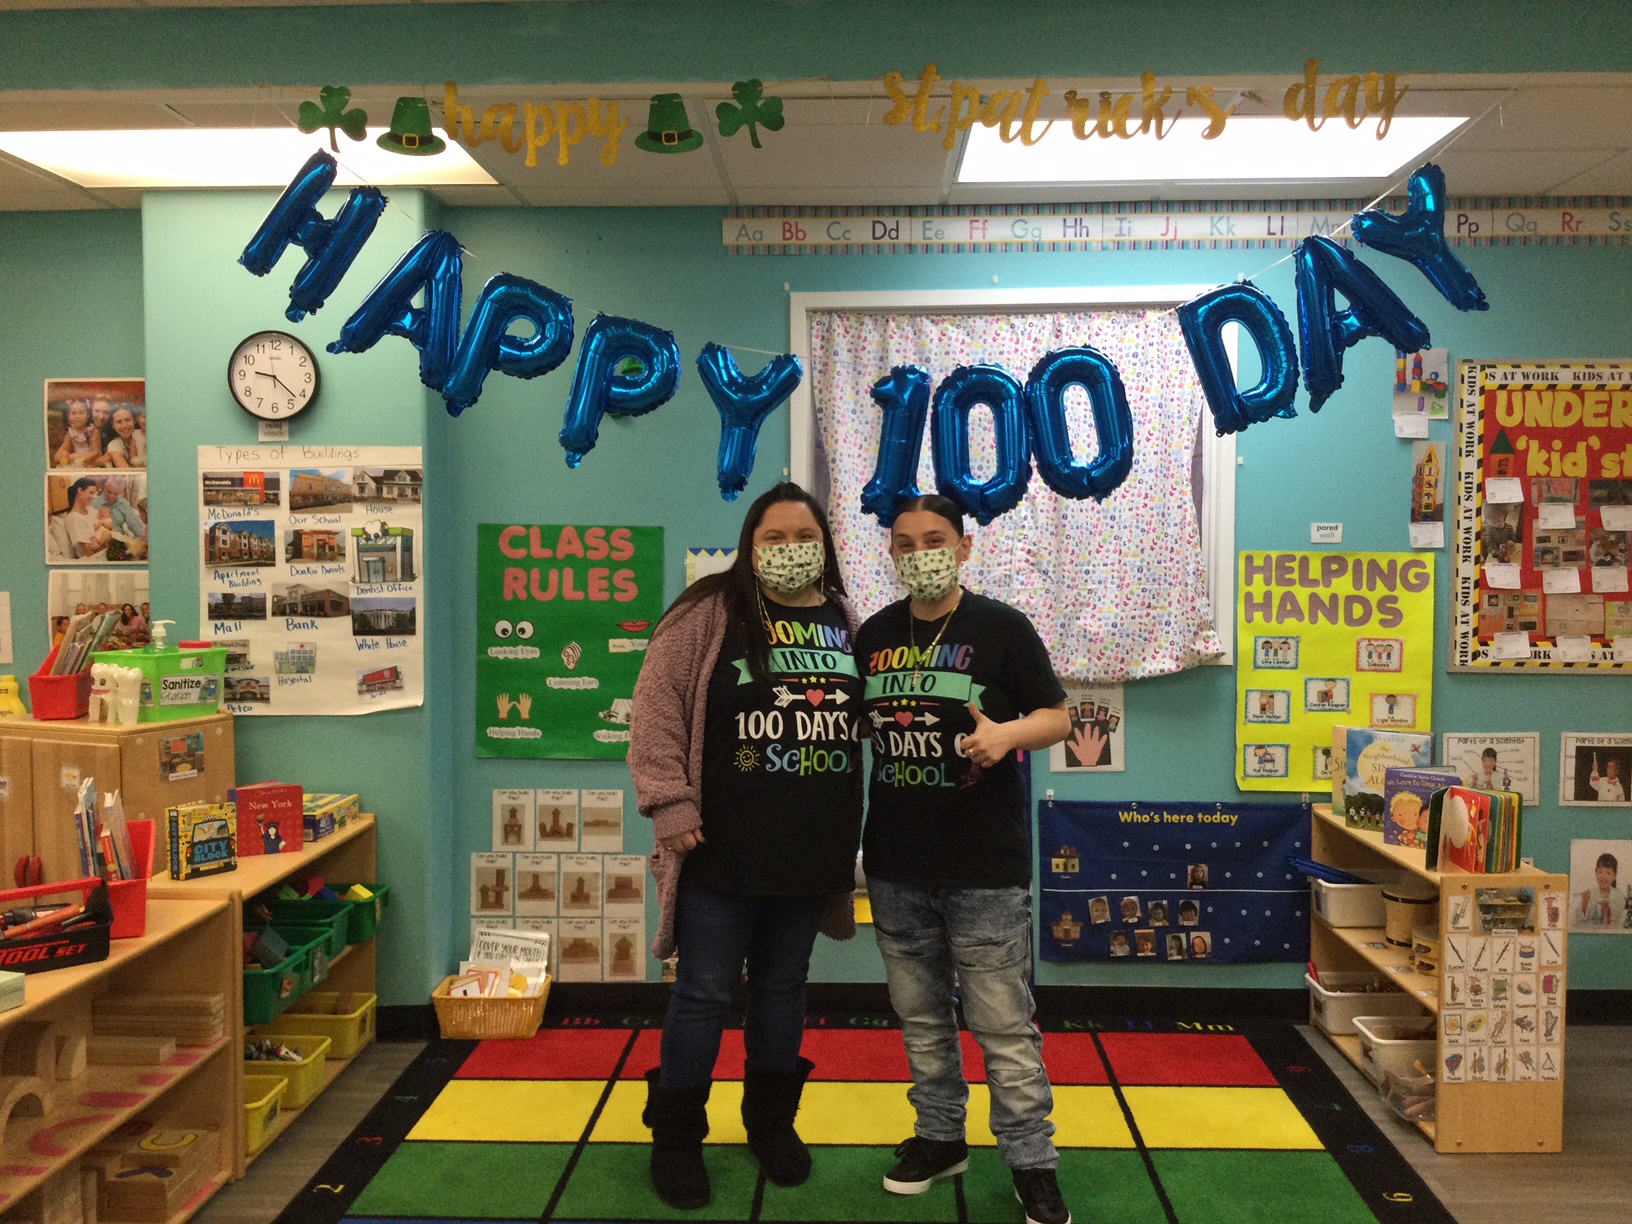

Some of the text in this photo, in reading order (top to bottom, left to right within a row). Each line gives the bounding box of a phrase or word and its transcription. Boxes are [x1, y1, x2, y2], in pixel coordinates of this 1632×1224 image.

[1283, 57, 1411, 141] day
[443, 81, 631, 167] happy
[734, 219, 764, 242] Aa
[781, 219, 807, 242] Bb
[826, 220, 852, 242] Cc
[871, 219, 900, 241] Dd
[921, 220, 945, 242] Ee
[968, 219, 989, 241] Ff
[1010, 218, 1041, 245] Gg
[1062, 216, 1090, 239] Hh
[1114, 216, 1131, 238] Ii
[1160, 215, 1178, 242] Jj
[1209, 216, 1236, 237] Kk
[1267, 215, 1284, 236] Ll
[1456, 213, 1480, 239] Pp
[1505, 212, 1538, 236] Qq
[1561, 211, 1584, 232] Rr
[238, 149, 1489, 524] HAPPY 100 DAY
[255, 343, 265, 354] 11
[269, 339, 281, 351] 12
[289, 345, 295, 355] 1
[243, 355, 255, 366] 10
[299, 356, 307, 367] 2
[239, 369, 246, 381] 9
[304, 372, 312, 384] 3
[1501, 371, 1517, 382] AT
[1521, 371, 1560, 381] WORK
[1572, 371, 1603, 381] KIDS
[1608, 371, 1623, 381] AT
[244, 386, 251, 397] 8
[299, 389, 306, 400] 4
[256, 397, 264, 408] 7
[271, 402, 278, 414] 6
[287, 398, 295, 410] 5
[1465, 365, 1477, 459] KIDS AT WORK
[1495, 390, 1632, 428] UNDER
[265, 421, 283, 431] reloj
[264, 430, 285, 438] clock
[216, 445, 360, 464] Types of Buildings
[365, 504, 394, 515] House
[289, 514, 342, 525] Our School
[1462, 471, 1474, 563] KIDS AT WORK
[1316, 524, 1339, 533] pared
[498, 525, 635, 561] CLASS
[214, 568, 261, 582] Apartment
[1243, 554, 1430, 593] HELPING
[228, 578, 262, 588] Building
[503, 567, 639, 602] RULES
[356, 583, 414, 596] Dentist Office
[1243, 590, 1404, 628] HANDS
[214, 621, 242, 634] Mall
[286, 618, 318, 631] Bank
[1459, 576, 1471, 667] KIDS AT WORK
[767, 619, 852, 654] OOMING
[386, 637, 409, 650] House
[490, 647, 539, 656] Looking Eyes
[1600, 650, 1615, 661] AT
[779, 651, 837, 671] INTO
[869, 643, 974, 674] ZOOMING
[162, 678, 202, 690] Sanitize
[278, 675, 312, 686] Hospital
[548, 679, 581, 687] Listening
[882, 674, 937, 694] INTO
[161, 690, 191, 703] Station
[735, 710, 785, 740] 100
[795, 711, 850, 741] DAYS
[488, 729, 541, 738] Helping Hands
[594, 732, 621, 740] Walking
[888, 731, 943, 758] DAYS
[1495, 737, 1525, 745] scientist
[879, 760, 956, 787] CHOOL
[1396, 779, 1412, 787] Love
[249, 799, 293, 810] New York
[1118, 811, 1240, 827] Who's here today
[194, 839, 228, 855] CITY
[194, 851, 228, 863] BLOCK
[54, 943, 88, 958] SET
[479, 940, 542, 957] COVER YOUR MOUTH
[1174, 1020, 1235, 1031] Mm
